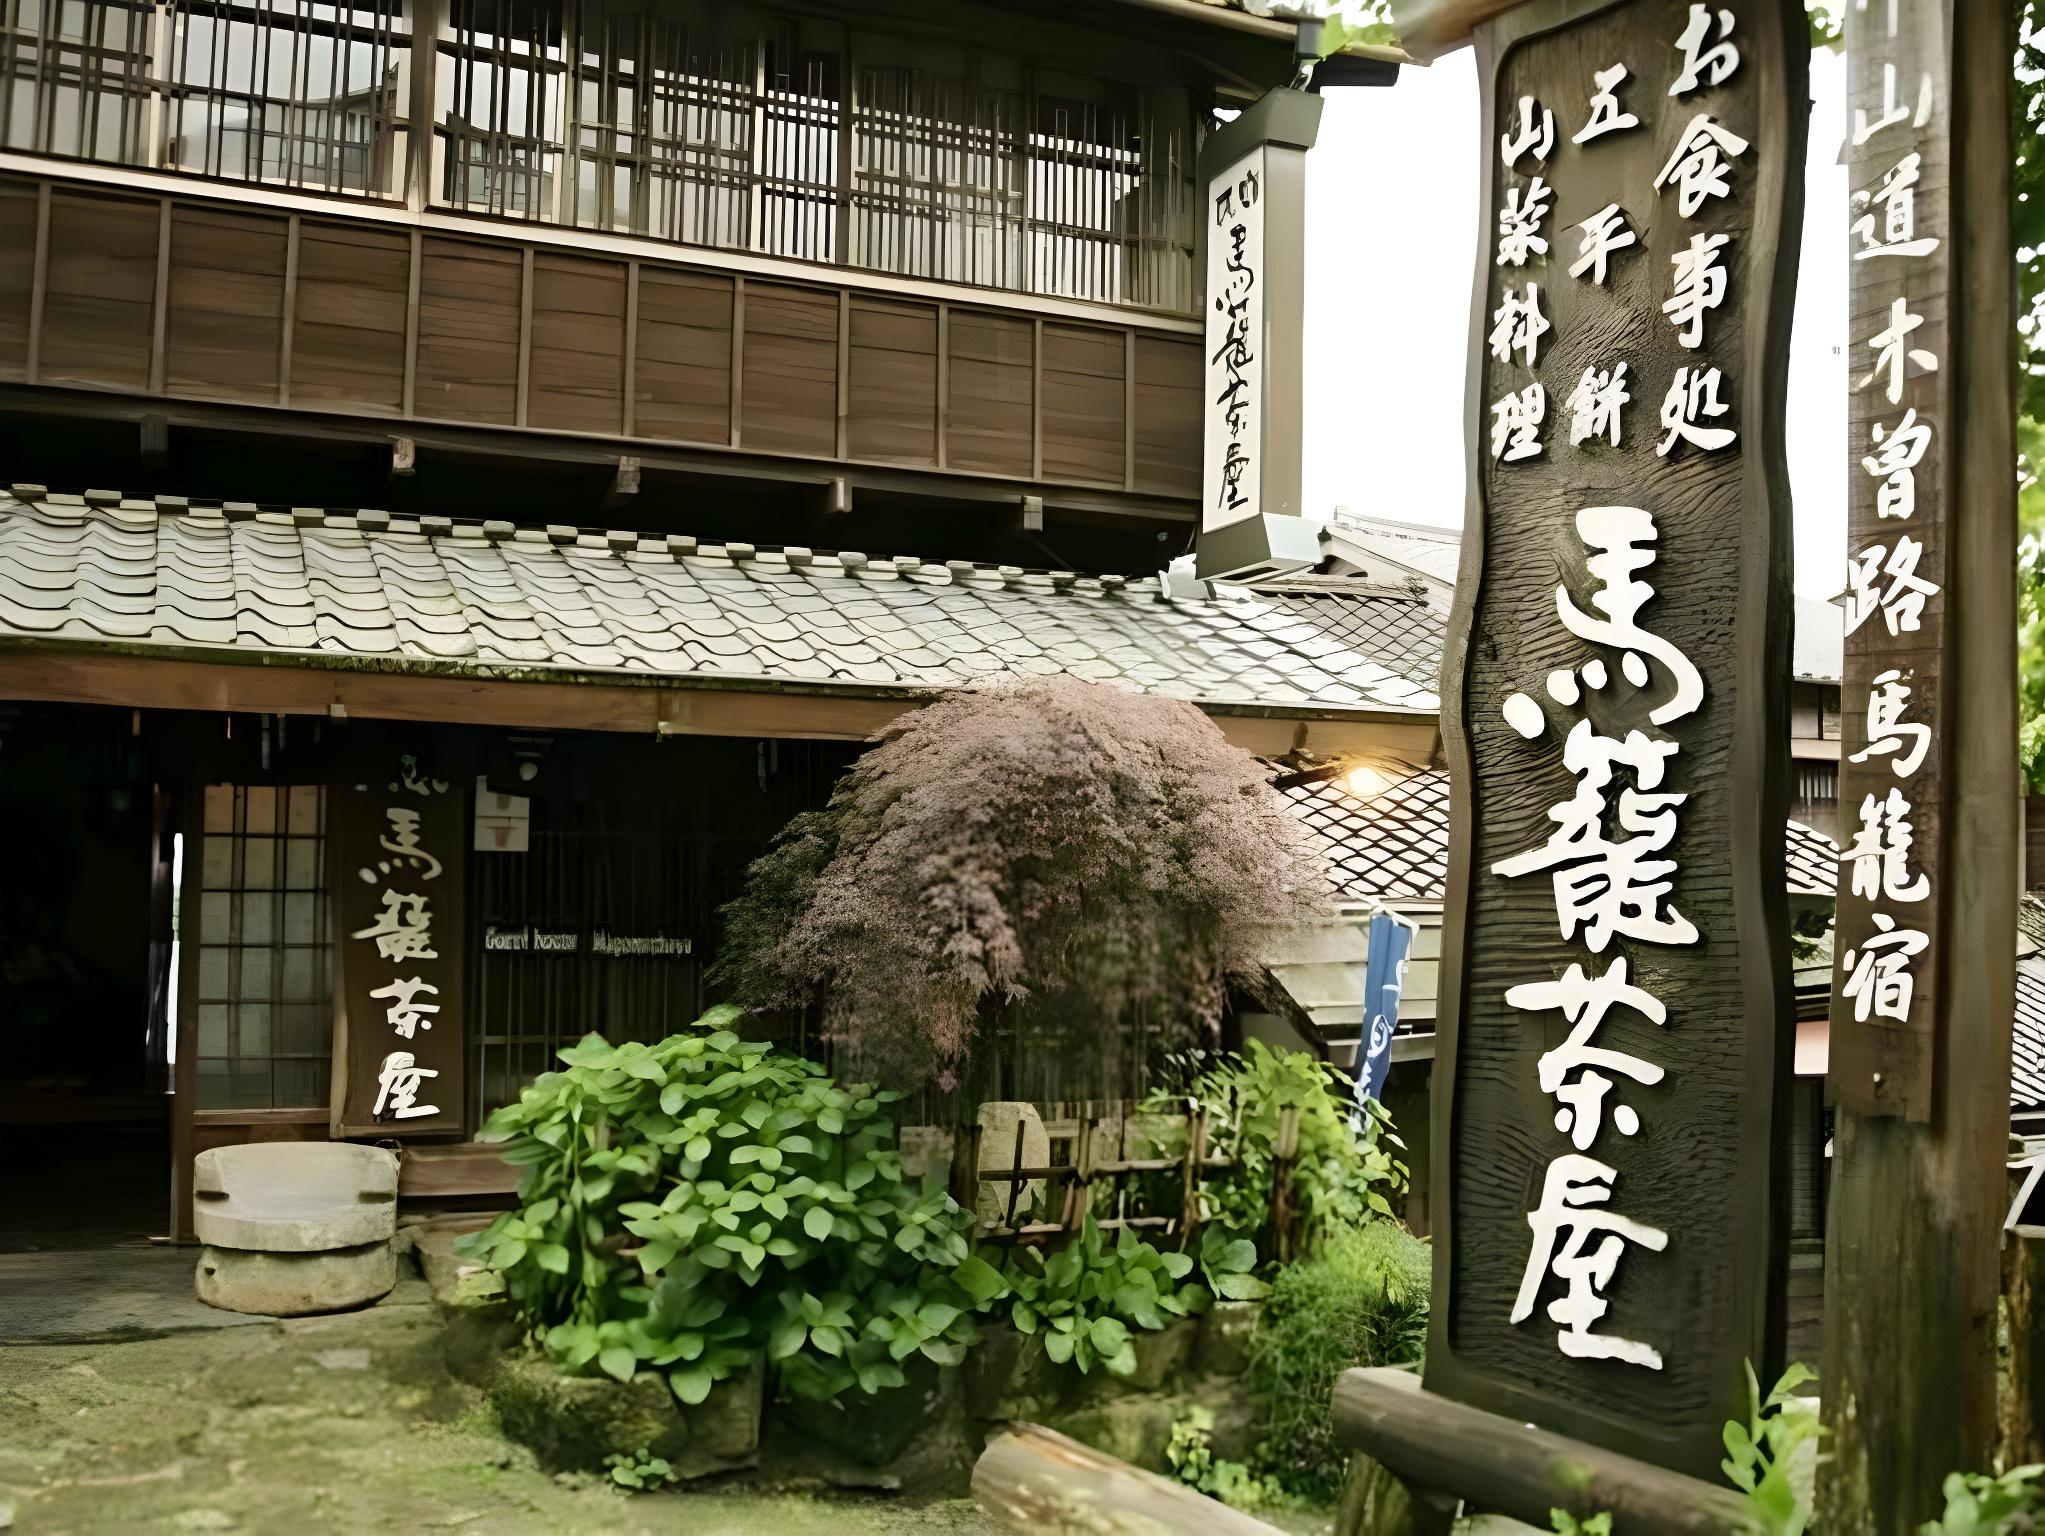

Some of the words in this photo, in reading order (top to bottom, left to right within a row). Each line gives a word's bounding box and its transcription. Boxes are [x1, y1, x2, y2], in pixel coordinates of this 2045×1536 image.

[1489, 95, 1554, 463] 山菜料理
[1567, 62, 1639, 447] 五平餅
[1653, 4, 1749, 457] お食事処
[1839, 0, 1941, 1022] 山道木曽路馬籠宿
[351, 807, 443, 1119] 馬籠茶屋
[1490, 506, 1704, 1370] 馬籠茶屋
